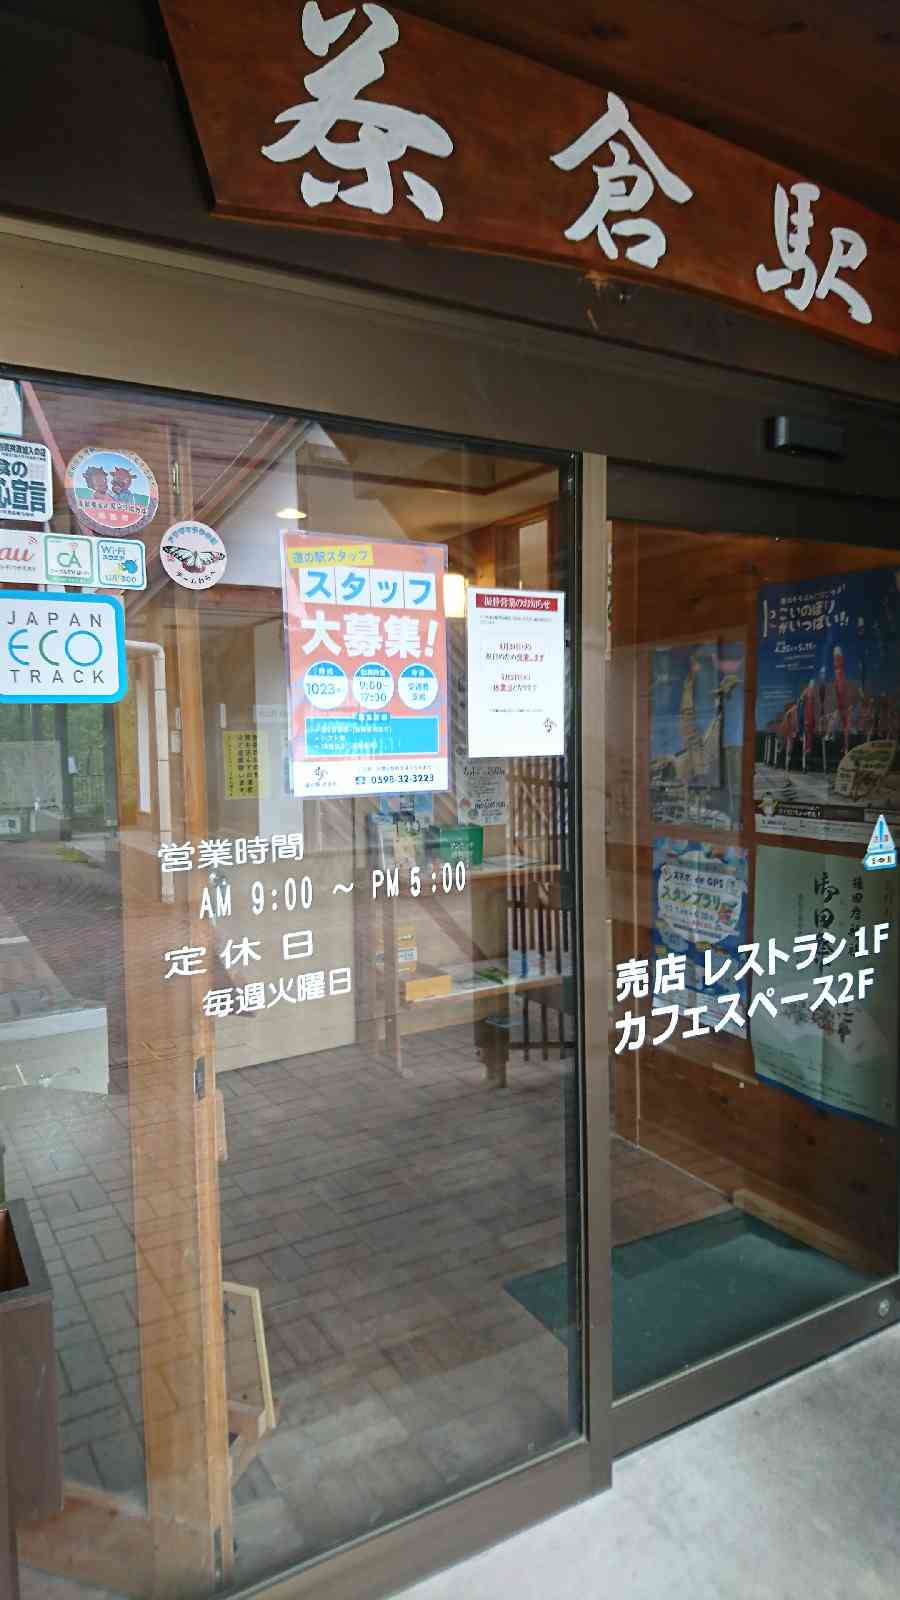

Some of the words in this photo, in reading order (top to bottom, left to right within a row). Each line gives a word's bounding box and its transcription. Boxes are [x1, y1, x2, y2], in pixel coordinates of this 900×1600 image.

[261, 0, 873, 325] 茶倉駅
[305, 570, 432, 605] スタッフ
[8, 610, 102, 627] JAPAN
[8, 629, 103, 667] ECO
[9, 669, 104, 684] TRACK
[157, 832, 305, 873] 営業時間
[199, 888, 232, 919] AM
[251, 876, 314, 915] 9:00
[372, 867, 400, 899] PM
[164, 930, 315, 979] 定休日
[615, 952, 687, 1002] 売店
[704, 922, 890, 986] レストラン1F
[201, 967, 352, 1018] 毎週火曜日
[614, 967, 875, 1055] カフェスペース2F
